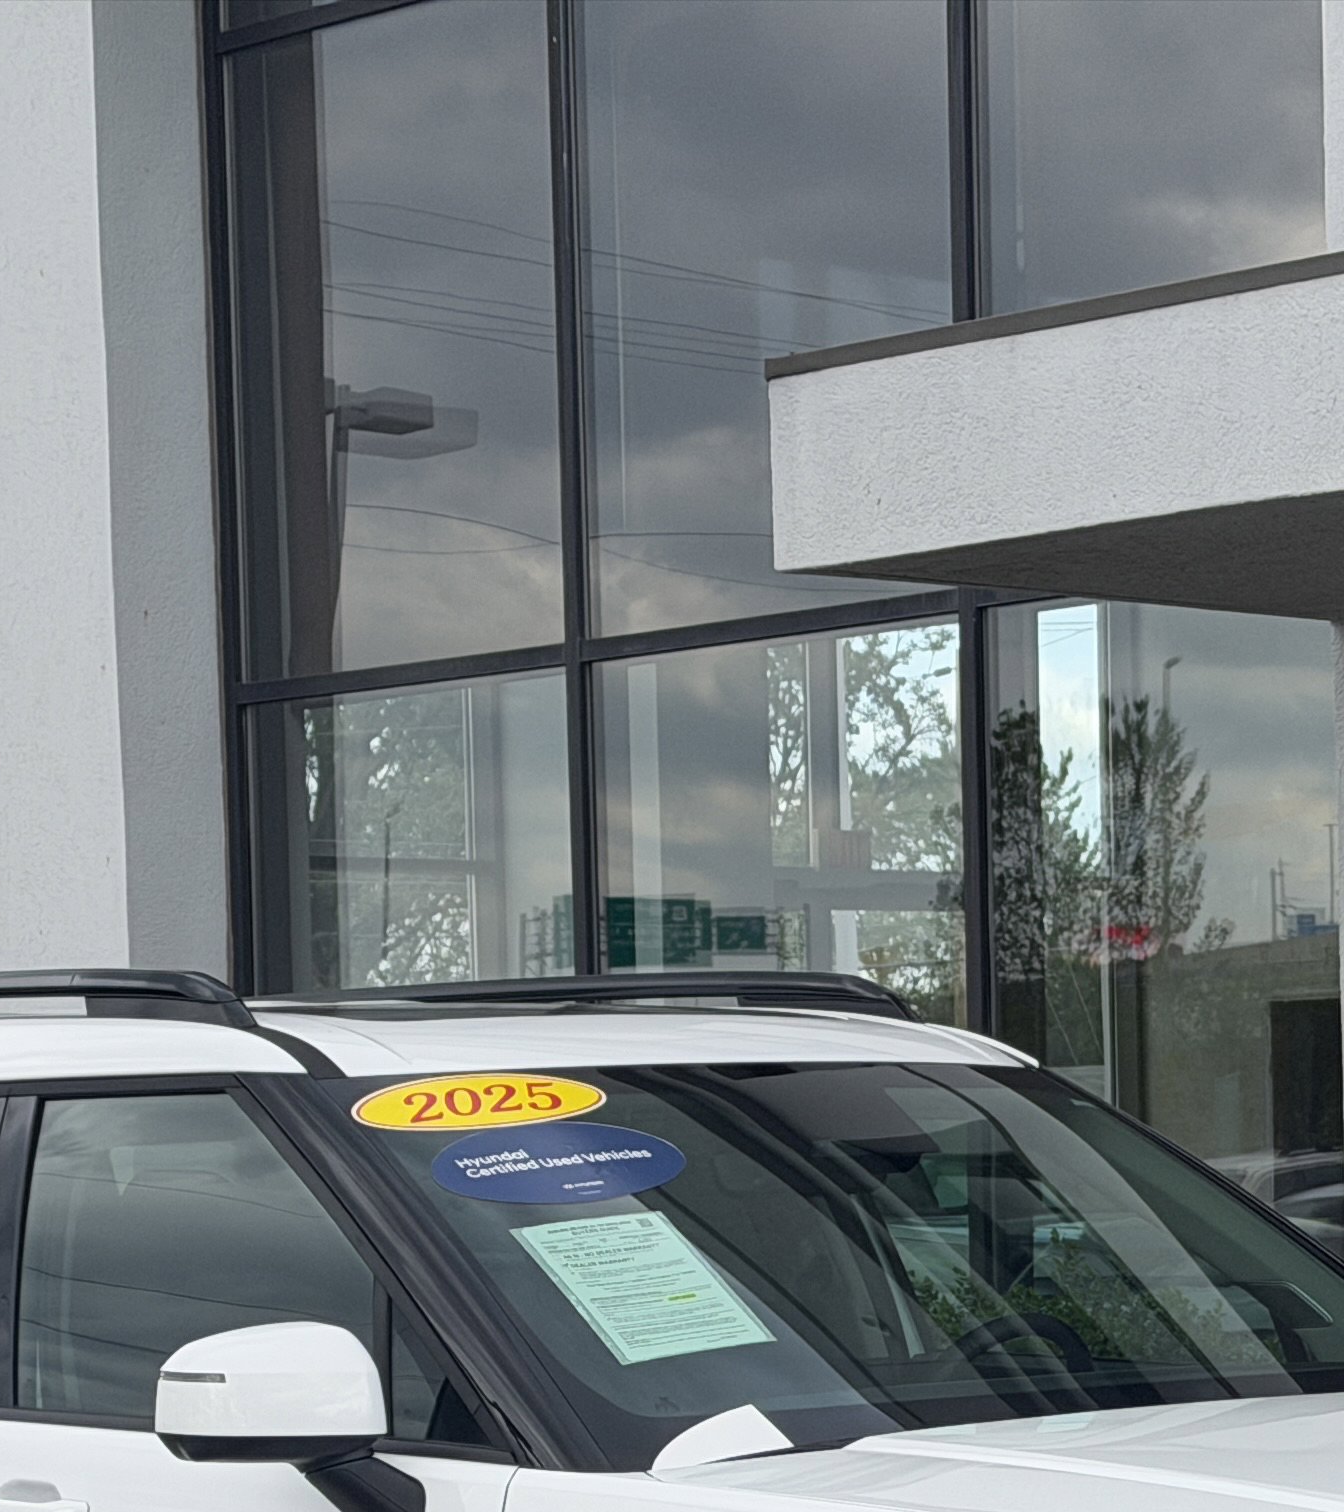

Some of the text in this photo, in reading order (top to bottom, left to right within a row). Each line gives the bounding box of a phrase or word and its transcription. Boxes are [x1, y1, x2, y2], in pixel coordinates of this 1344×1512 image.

[403, 1082, 562, 1123] 2025
[455, 1149, 529, 1169] Hyundai
[466, 1149, 652, 1179] Certified Used Vehicles
